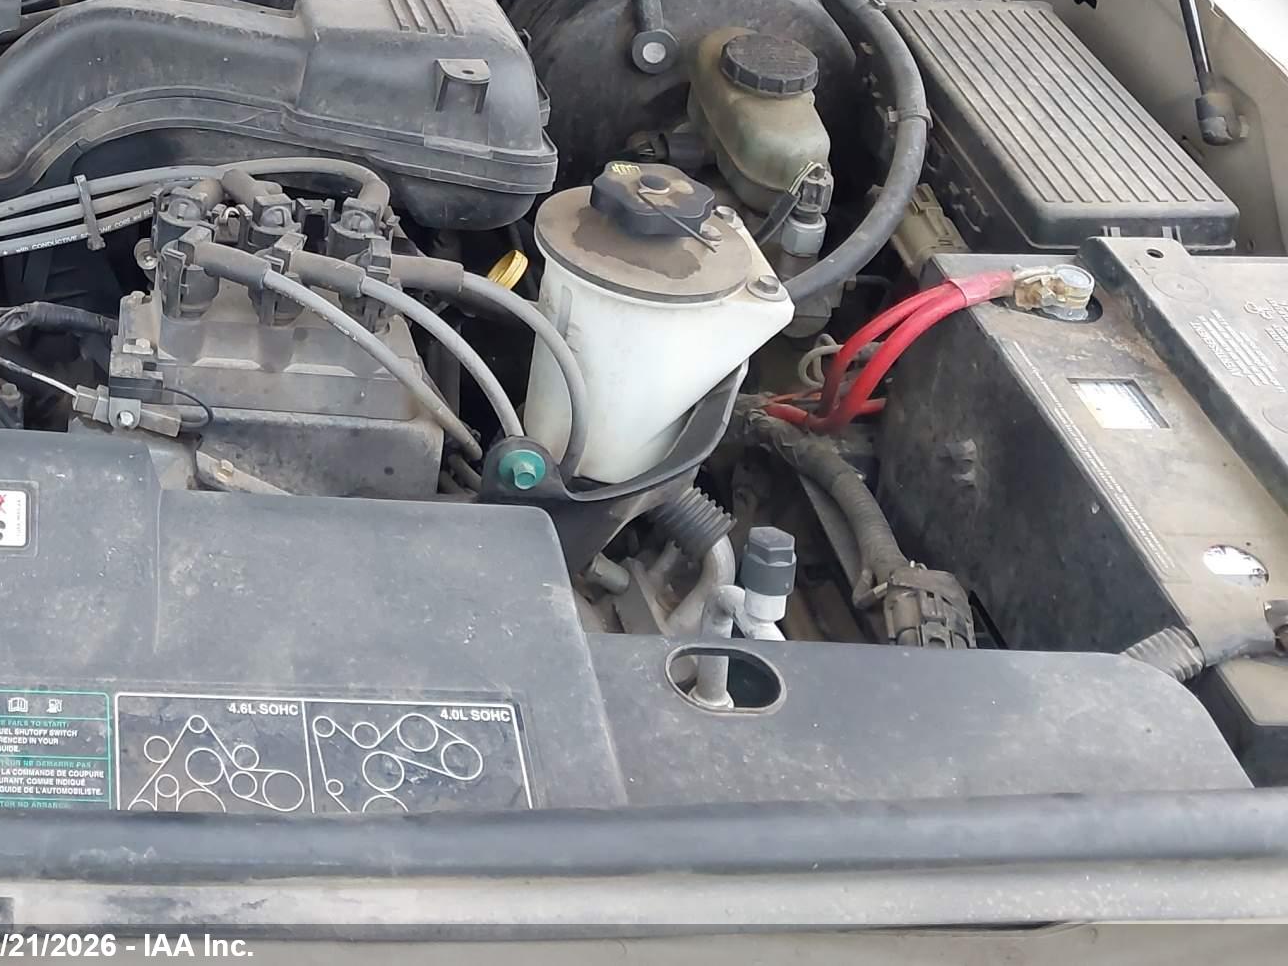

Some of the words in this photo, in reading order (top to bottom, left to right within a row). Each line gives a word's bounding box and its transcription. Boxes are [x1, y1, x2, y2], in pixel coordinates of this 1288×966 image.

[228, 703, 256, 715] 4.6L
[258, 703, 299, 716] SOHC
[440, 708, 468, 721] 4.0L
[470, 710, 511, 723] SOHC
[14, 728, 47, 737] SHUTOFF
[48, 729, 78, 737] SWITCH
[0, 768, 11, 776] LA
[12, 768, 54, 777] COMMANDE
[56, 769, 67, 777] DE
[68, 770, 104, 778] COUPURE
[23, 786, 34, 794] DE
